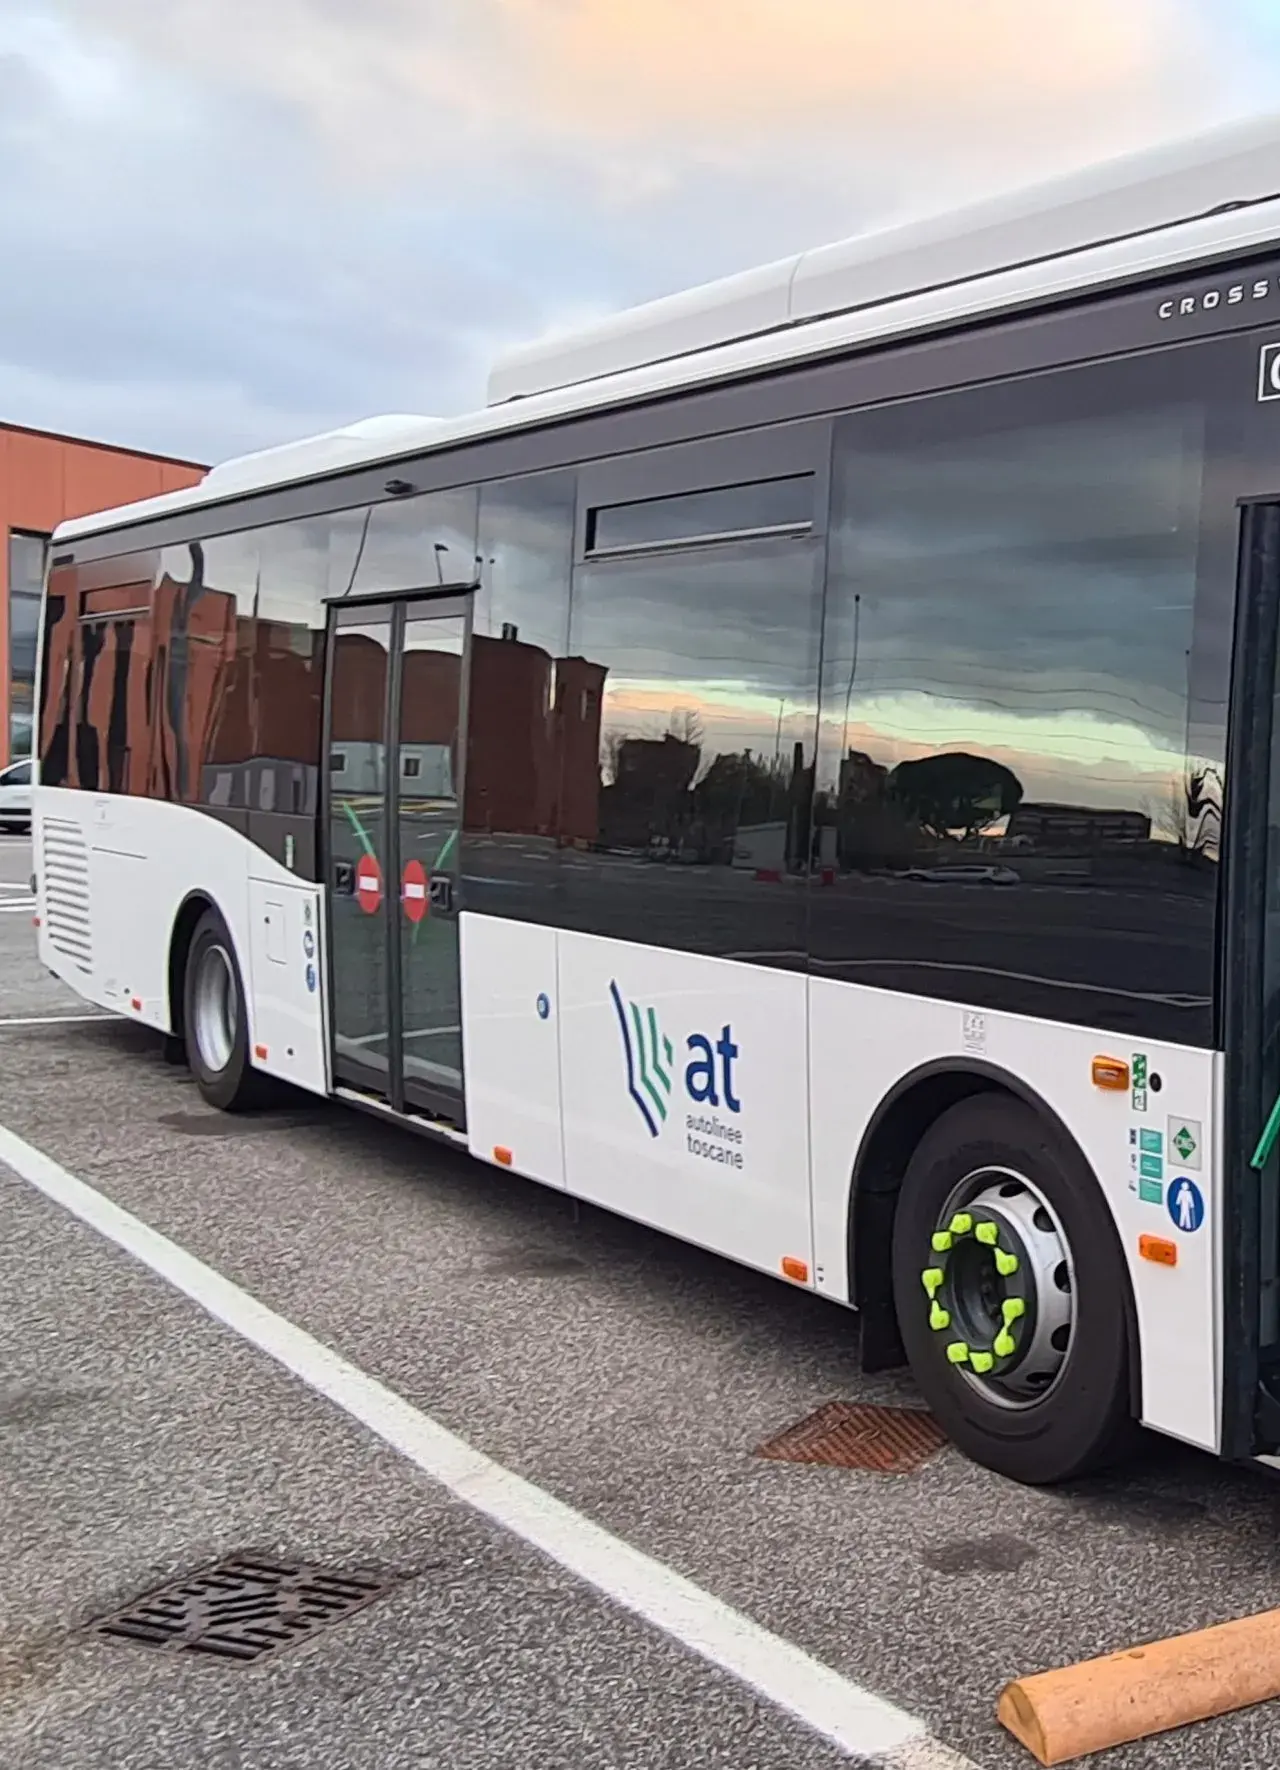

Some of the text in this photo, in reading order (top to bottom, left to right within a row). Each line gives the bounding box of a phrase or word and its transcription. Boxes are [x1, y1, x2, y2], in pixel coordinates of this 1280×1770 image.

[685, 1024, 741, 1113] at
[686, 1113, 742, 1144] autolinee
[687, 1134, 743, 1169] toscane
